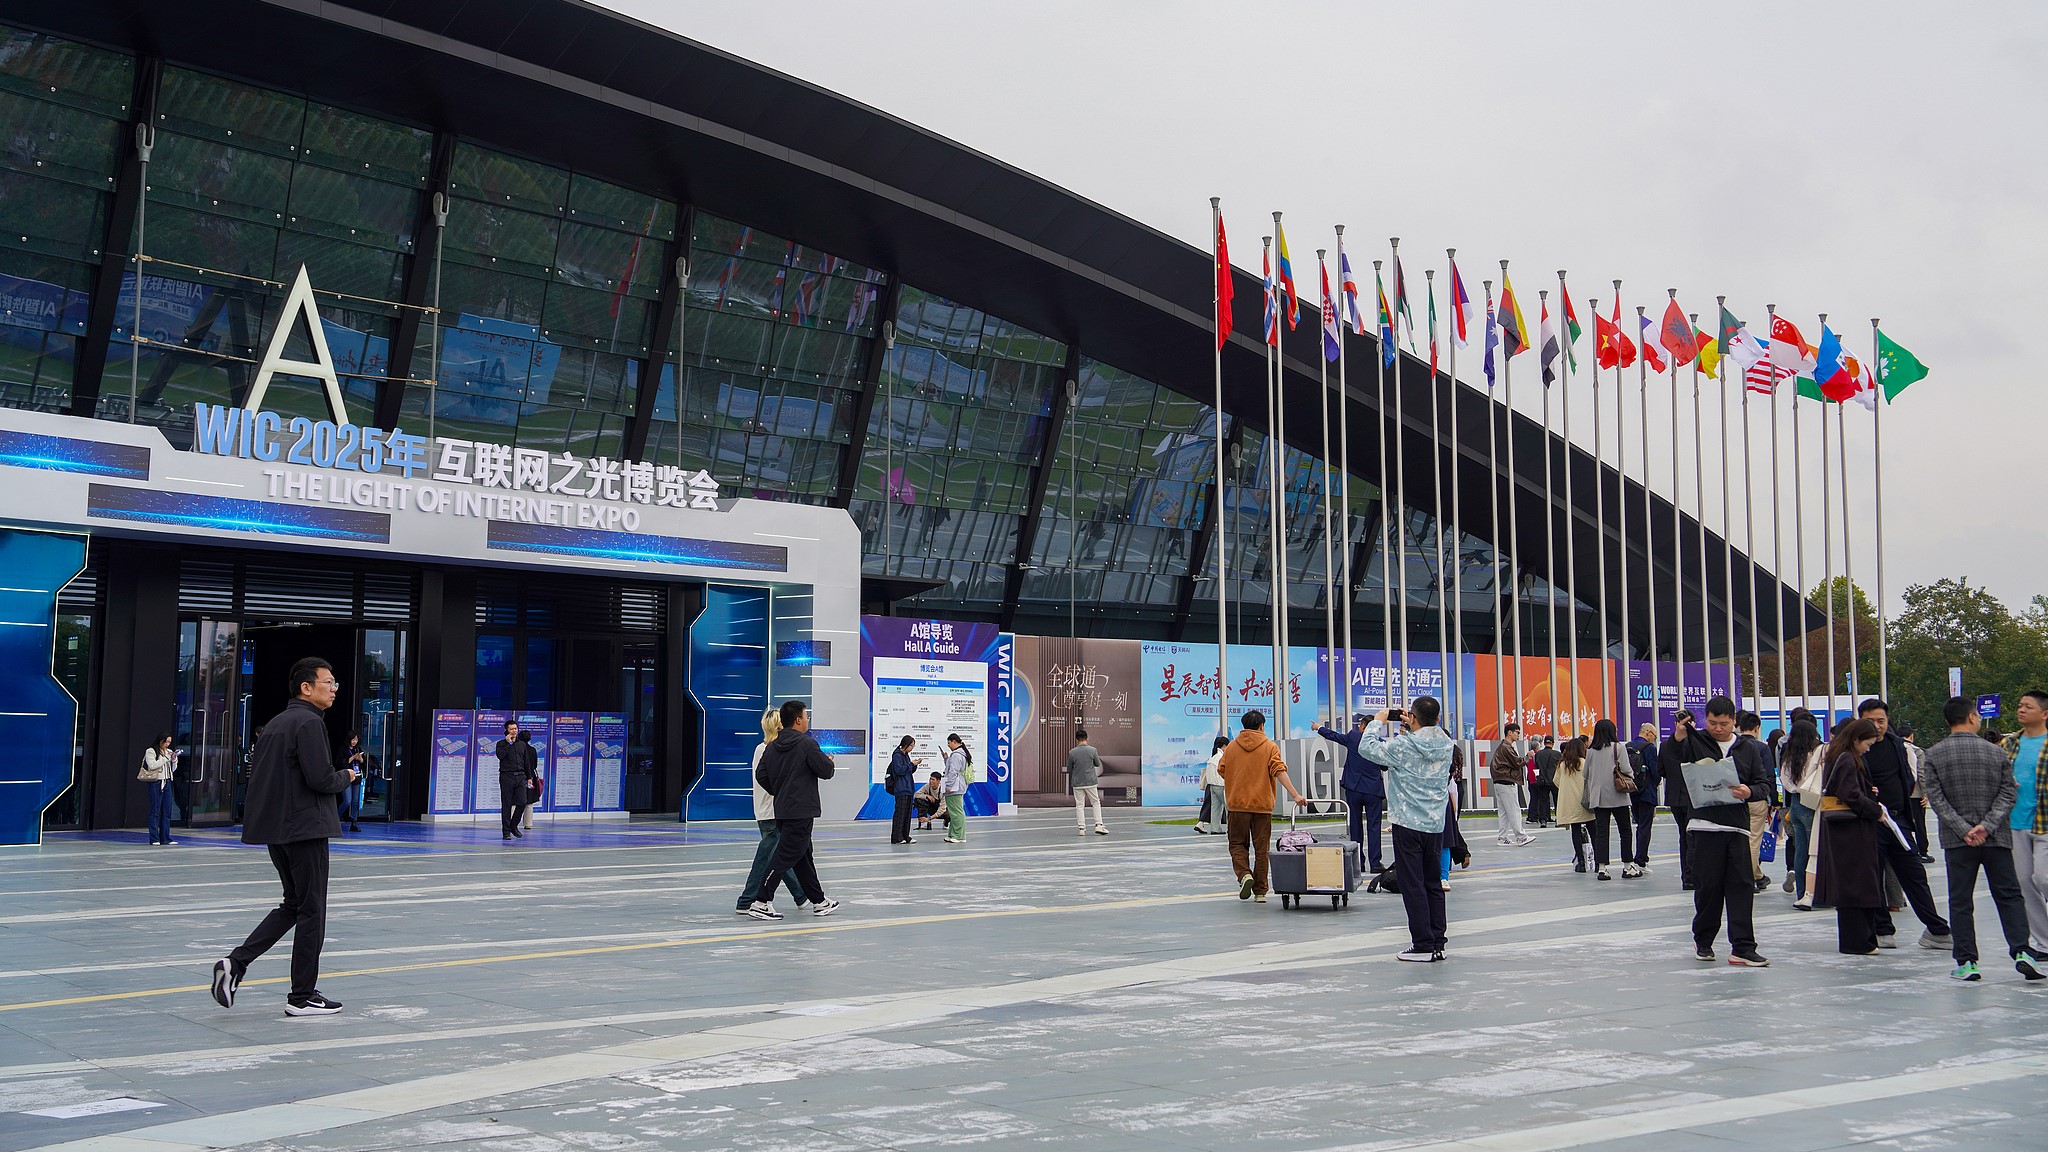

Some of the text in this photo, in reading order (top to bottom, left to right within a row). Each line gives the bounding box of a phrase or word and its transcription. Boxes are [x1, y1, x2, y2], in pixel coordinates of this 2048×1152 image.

[245, 264, 348, 426] A
[194, 402, 720, 511] WIC 2025年 互联网之光博览会
[263, 469, 640, 531] THE LIGHT OF INTERNET EXPO
[910, 622, 954, 641] A馆导览
[904, 640, 960, 654] Hall A Guide
[998, 644, 1011, 698] WIC
[1047, 663, 1110, 689] 全球通
[1417, 688, 1433, 697] Cloud
[1660, 685, 1679, 695] WORL
[1684, 686, 1724, 696] 世界互联大会
